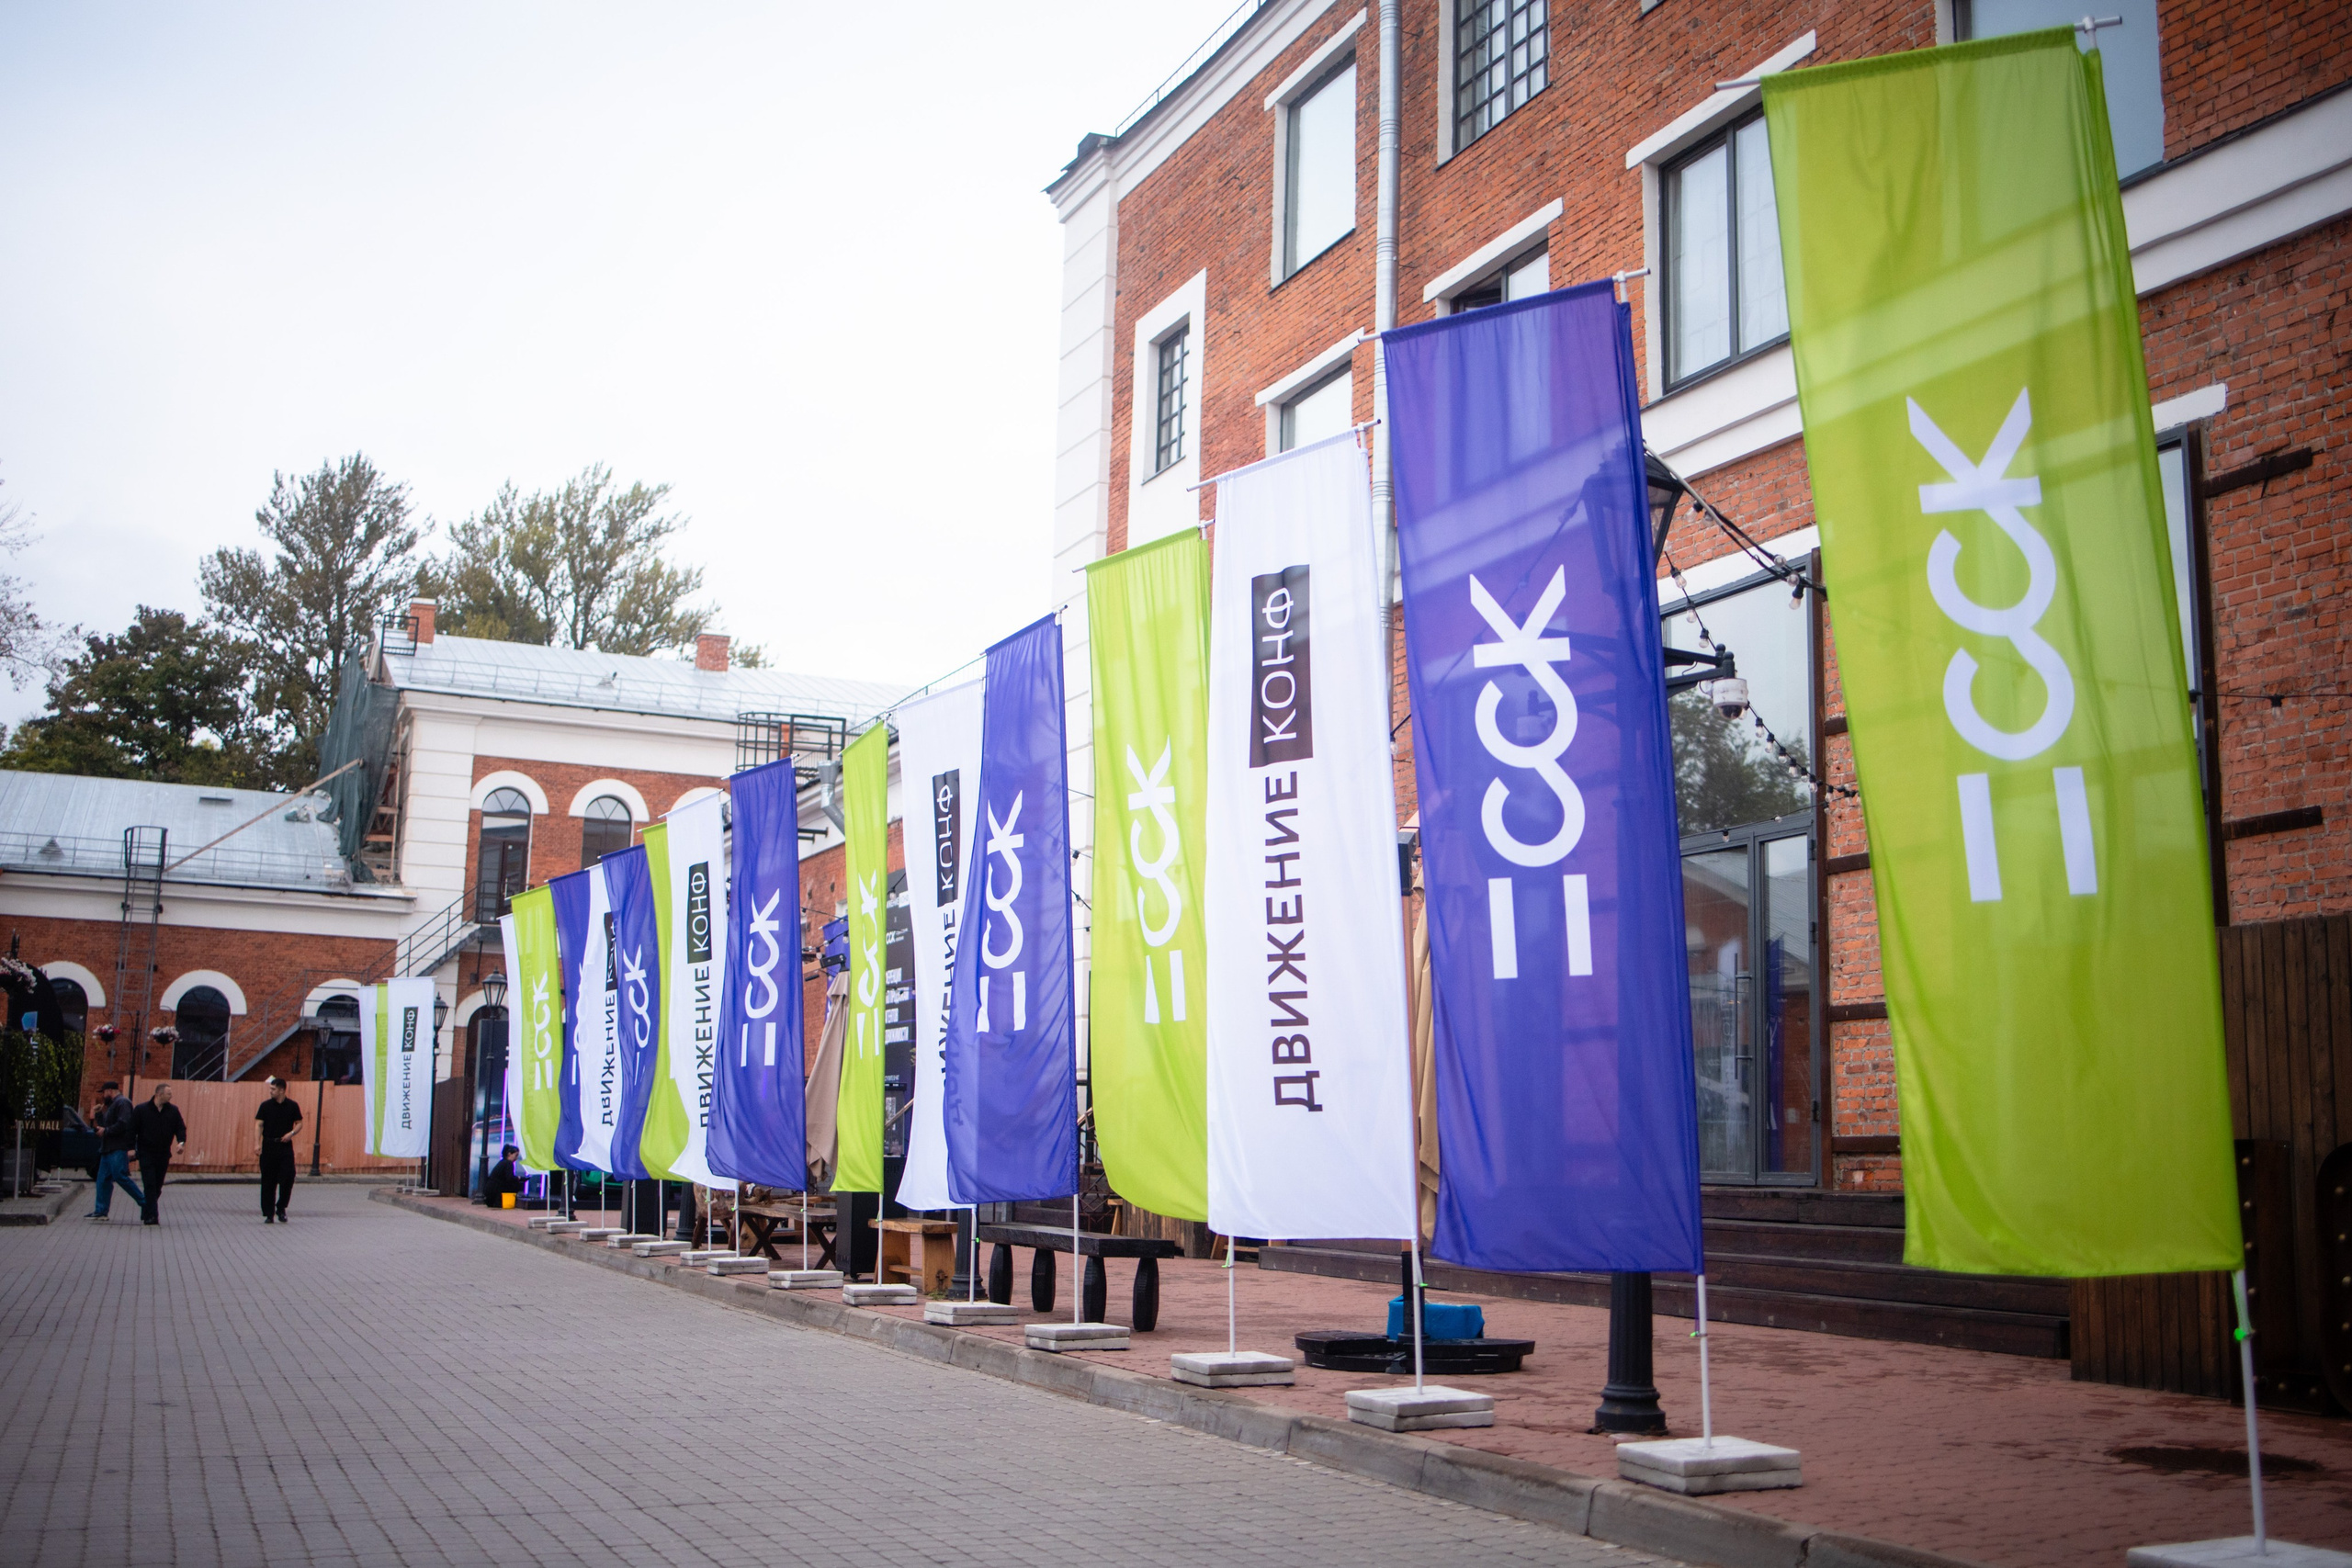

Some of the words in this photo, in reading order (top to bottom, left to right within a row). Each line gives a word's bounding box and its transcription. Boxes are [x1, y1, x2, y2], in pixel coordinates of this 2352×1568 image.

[1260, 586, 1300, 745] КОНФ
[937, 784, 955, 892] КОНФ
[690, 871, 710, 953] КОНФ
[1265, 772, 1323, 1113] ДВИЖЕНИЕ
[403, 1010, 416, 1048] КОНФ
[600, 993, 616, 1127] ДВИЖЕНИЕ
[40, 1120, 61, 1131] HALL
[401, 1054, 413, 1130] ДВИЖЕНИЕ
